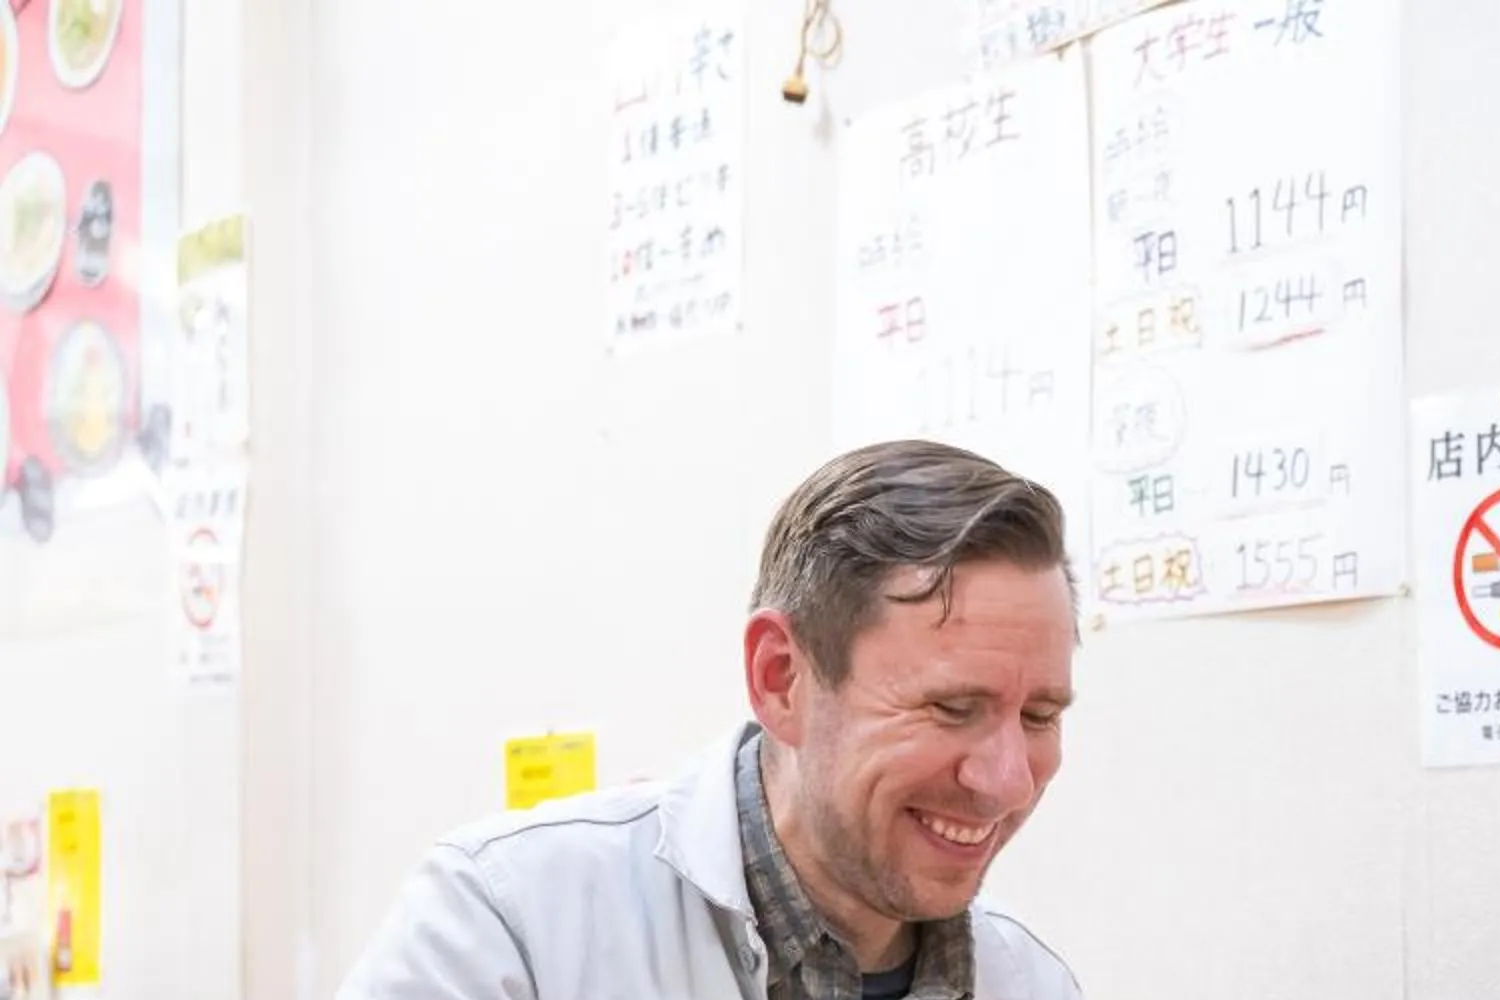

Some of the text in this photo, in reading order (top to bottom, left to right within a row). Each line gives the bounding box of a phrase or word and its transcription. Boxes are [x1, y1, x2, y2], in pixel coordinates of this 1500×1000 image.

[1132, 12, 1237, 88] 大学生
[1253, 0, 1324, 47] 一般
[899, 88, 1020, 179] 高校生
[1133, 229, 1177, 283] 平日
[876, 296, 926, 350] 平日
[1101, 295, 1200, 354] 土日祝
[1127, 472, 1175, 518] 平日
[1102, 546, 1195, 595] 土日祝
